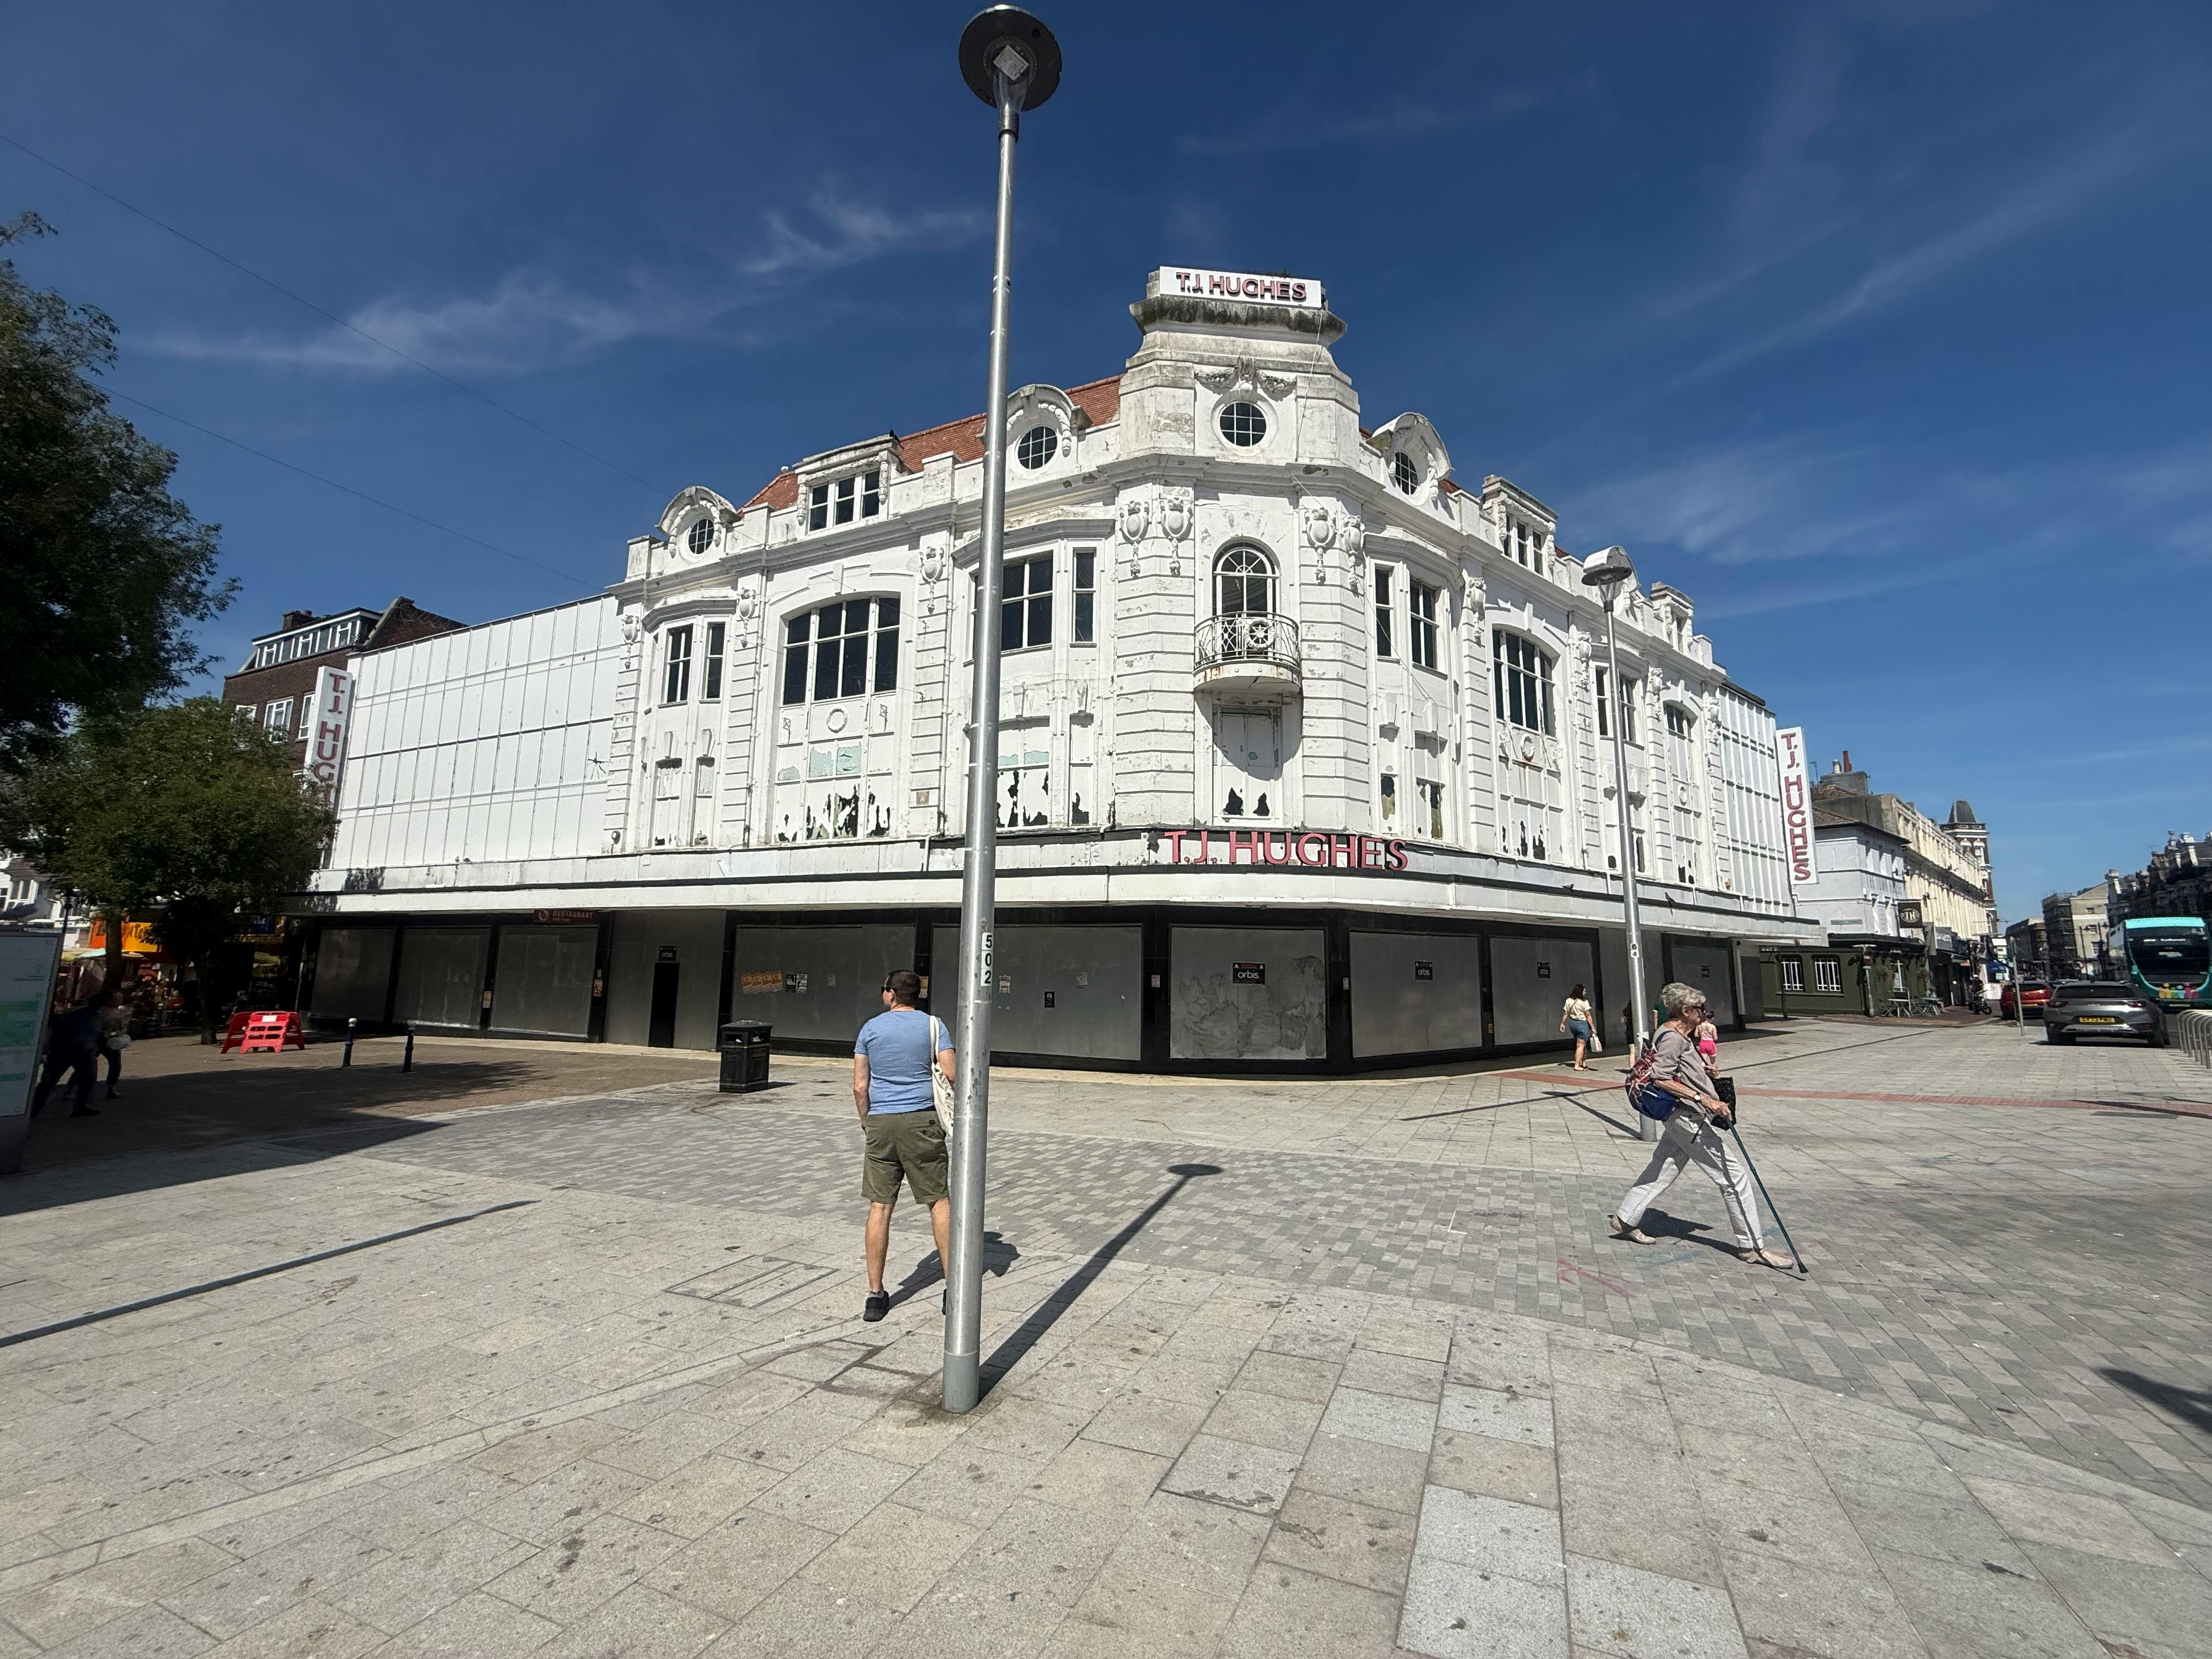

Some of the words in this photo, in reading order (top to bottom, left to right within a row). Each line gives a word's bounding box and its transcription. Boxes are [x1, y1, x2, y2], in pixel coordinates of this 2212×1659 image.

[1176, 272, 1203, 294] T.J.
[1209, 275, 1307, 302] HUGHES
[1784, 774, 1812, 881] HUGHES
[1164, 830, 1218, 865] T.J.
[1228, 830, 1409, 871] HUGHES
[552, 910, 593, 918] RESTAURANT
[1905, 911, 1916, 920] TH
[984, 935, 992, 984] 502
[1237, 970, 1259, 979] orbis
